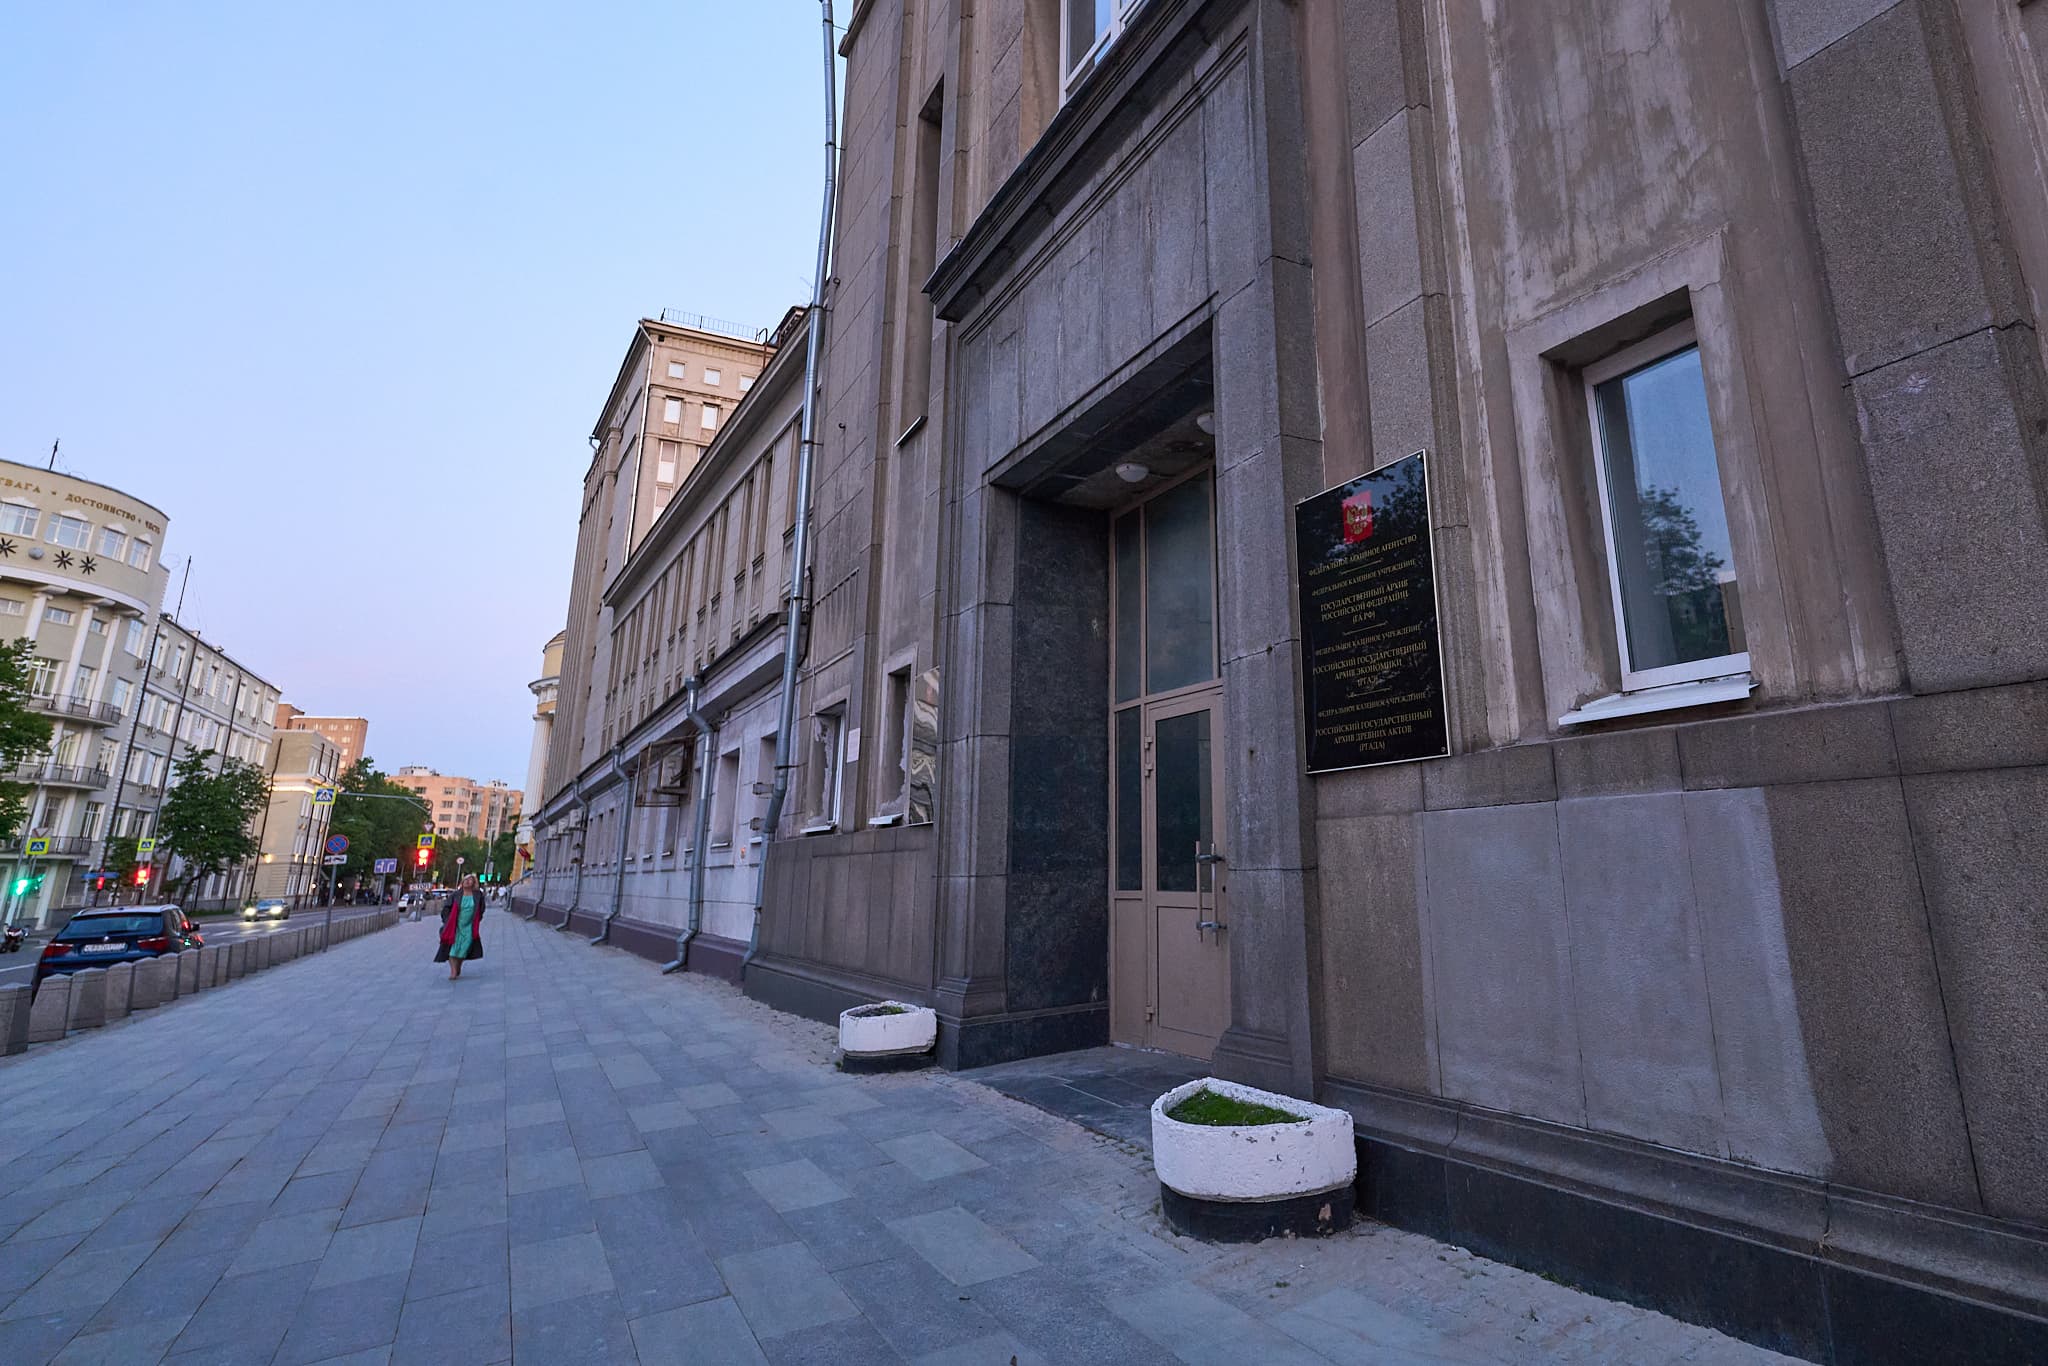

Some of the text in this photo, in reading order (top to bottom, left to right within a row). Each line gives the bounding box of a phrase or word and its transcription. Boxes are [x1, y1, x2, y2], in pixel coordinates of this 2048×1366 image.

[1380, 535, 1416, 551] АГЕНТСТВО
[1320, 579, 1409, 611] ГОСУДАРСТВЕННЫЙ АРХИВ
[1322, 590, 1408, 621] РОССИЙСКОЙ ФЕДЕРАЦИИ
[1312, 641, 1428, 675] РОССИЙСКИЙ ГОСУДАРСТВЕННЫЙ
[1356, 659, 1402, 675] ЭКОНОМИКИ
[1316, 709, 1432, 736] РОССИЙСКИЙ ГОСУДАРСТВЕННЫЙ
[1334, 725, 1412, 745] АРХИВ ДРЕВНИХ АКТОВ
[1360, 742, 1386, 751] (РГАДА)
